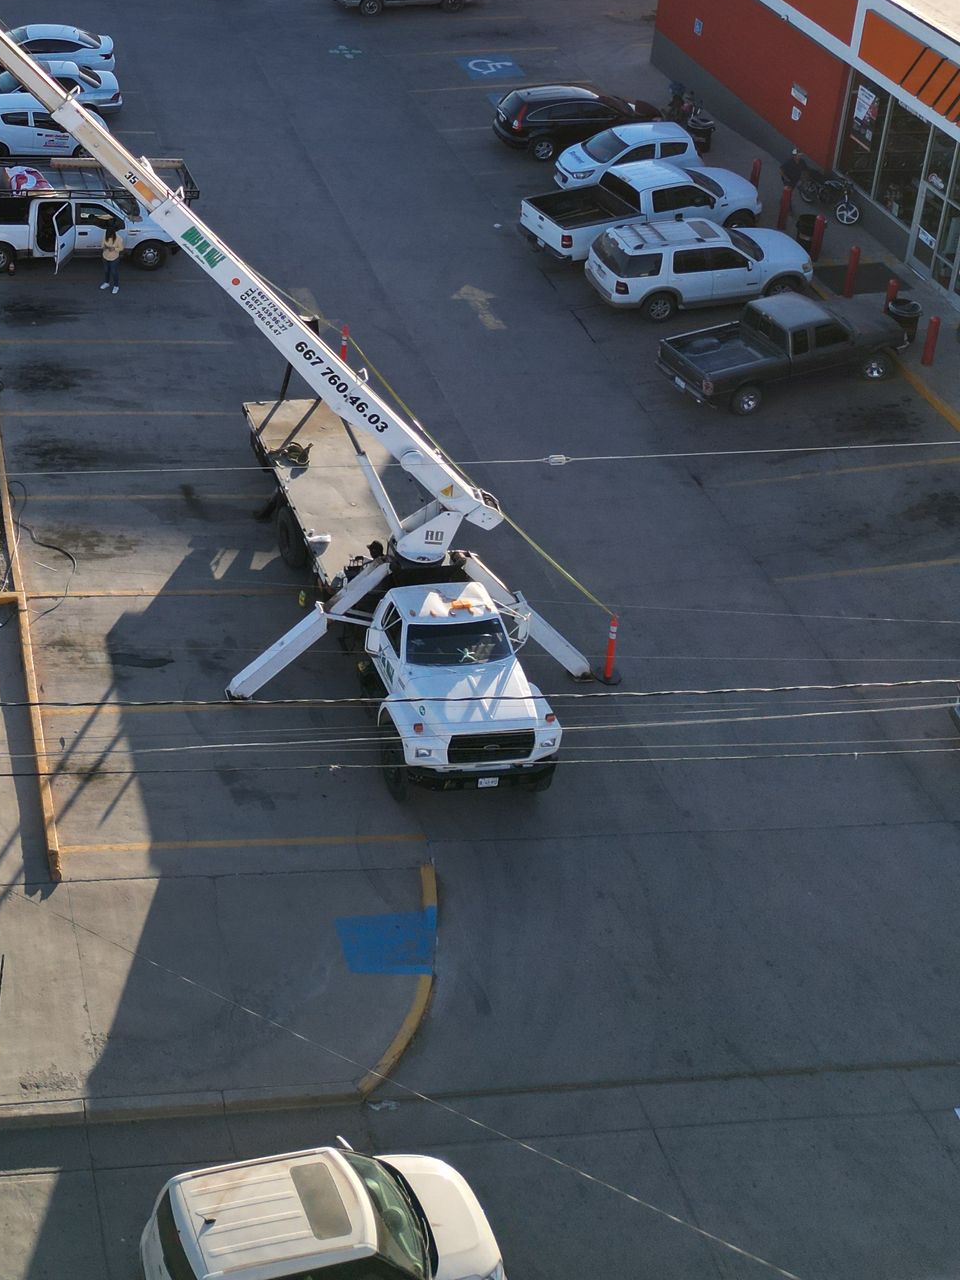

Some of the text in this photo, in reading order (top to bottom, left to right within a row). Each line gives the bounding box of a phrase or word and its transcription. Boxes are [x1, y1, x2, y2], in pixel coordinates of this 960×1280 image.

[124, 171, 140, 185] 35
[295, 341, 389, 433] 667 760.46.03
